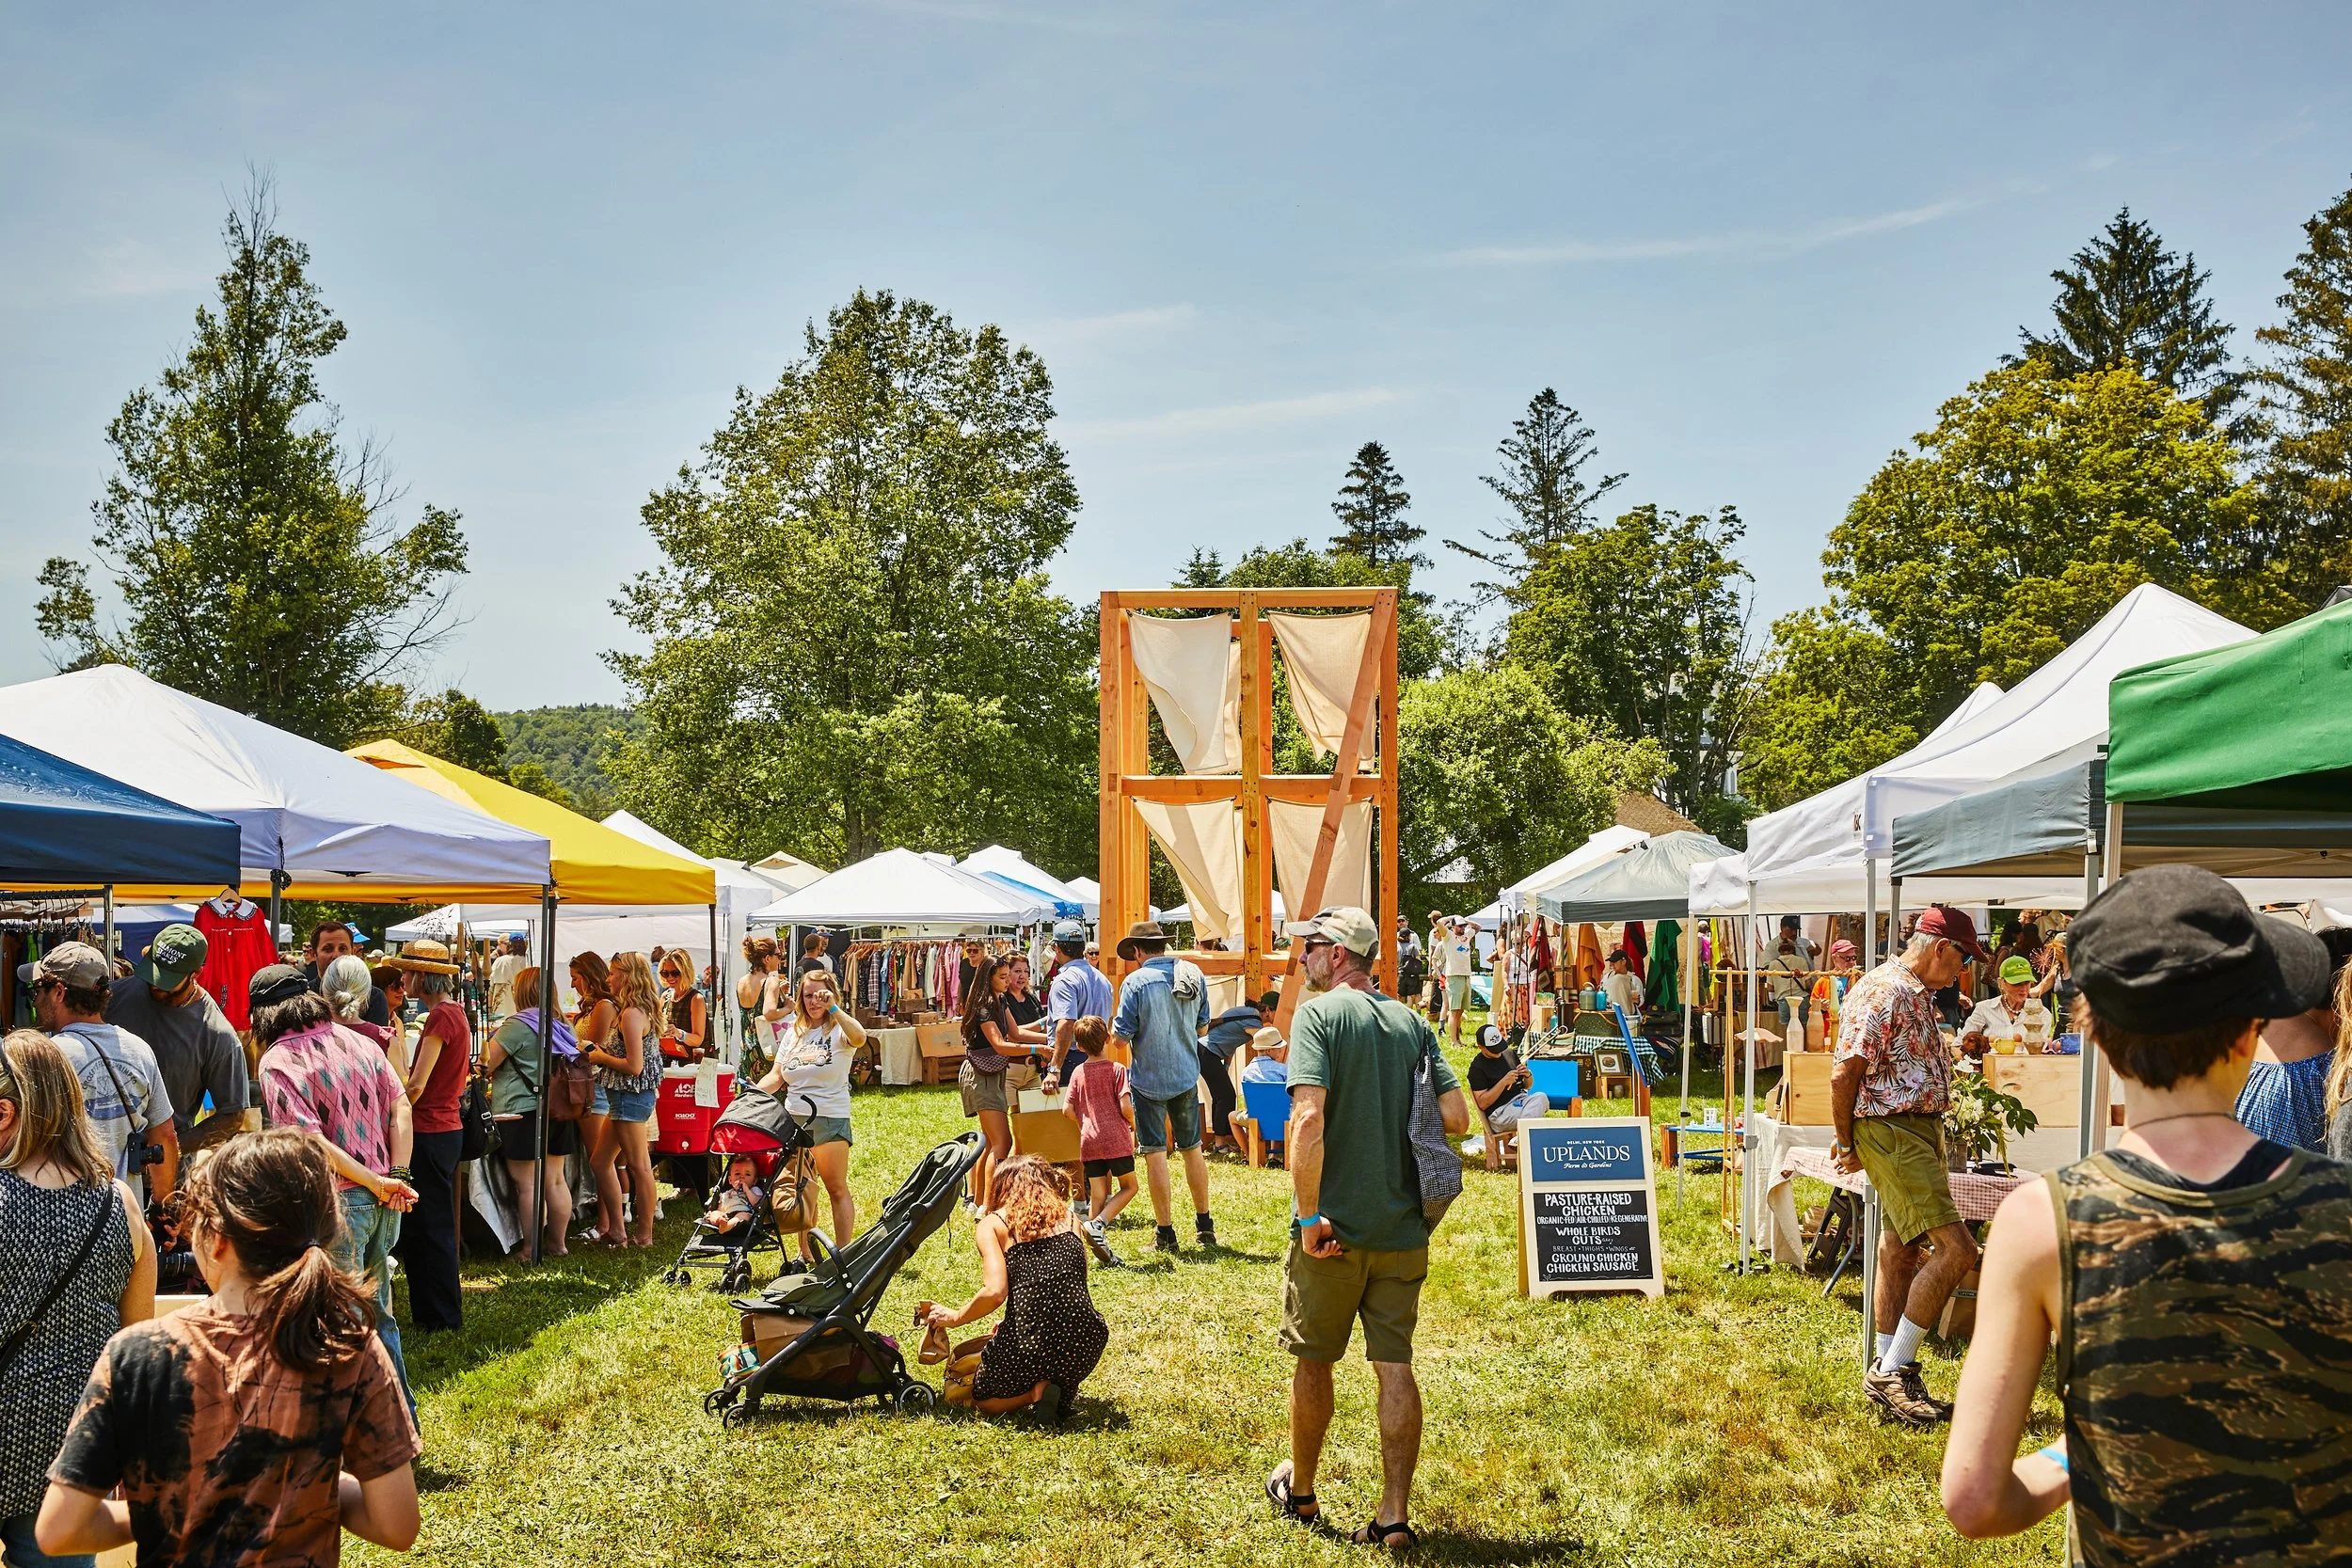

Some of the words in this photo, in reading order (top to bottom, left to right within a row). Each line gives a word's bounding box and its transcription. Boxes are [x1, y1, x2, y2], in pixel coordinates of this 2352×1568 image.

[157, 941, 187, 959] BELMONT
[157, 947, 179, 963] STAKES
[1543, 1145, 1630, 1163] UPLANDS
[1545, 1193, 1632, 1207] PASTURE-RAISED
[1562, 1205, 1616, 1217] CHICKEN
[1555, 1227, 1589, 1236] WHOLE
[1591, 1226, 1621, 1236] BIRDS
[1572, 1235, 1602, 1245] CUTS
[1551, 1254, 1596, 1263] GROUND
[1597, 1252, 1639, 1262] CHICKEN
[1546, 1263, 1591, 1274] CHICKEN
[1592, 1261, 1640, 1272] SAUSAGE
